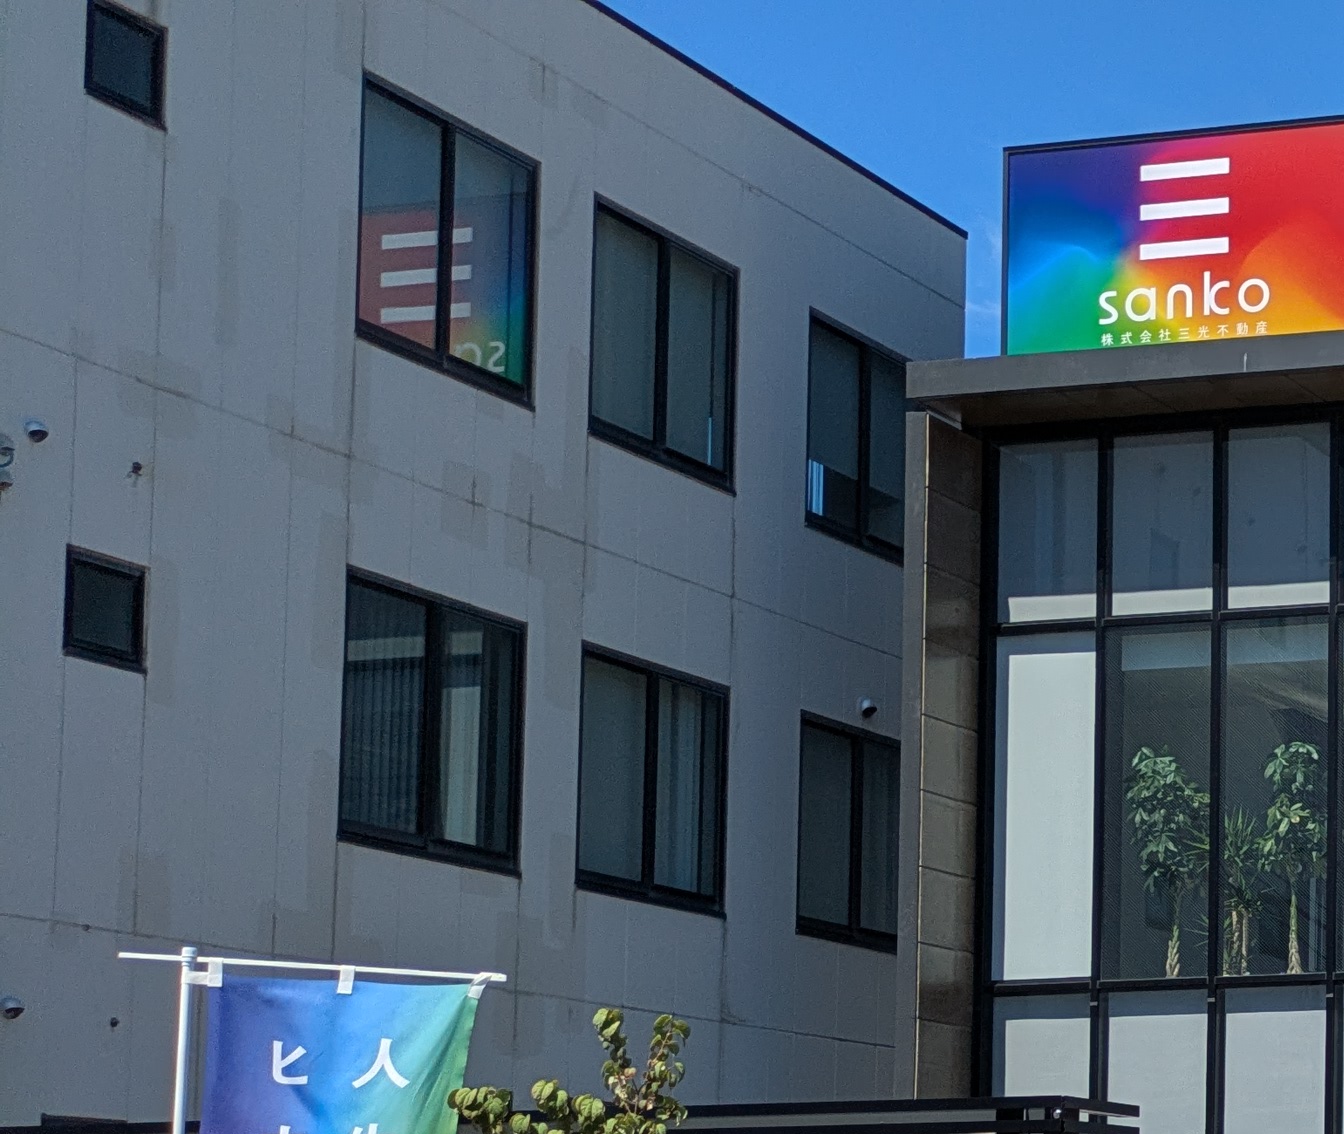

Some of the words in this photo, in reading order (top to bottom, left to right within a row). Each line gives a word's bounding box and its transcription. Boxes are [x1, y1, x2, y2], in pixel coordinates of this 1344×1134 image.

[1098, 270, 1271, 325] sanko
[1100, 320, 1269, 347] 株式会社三光不動産
